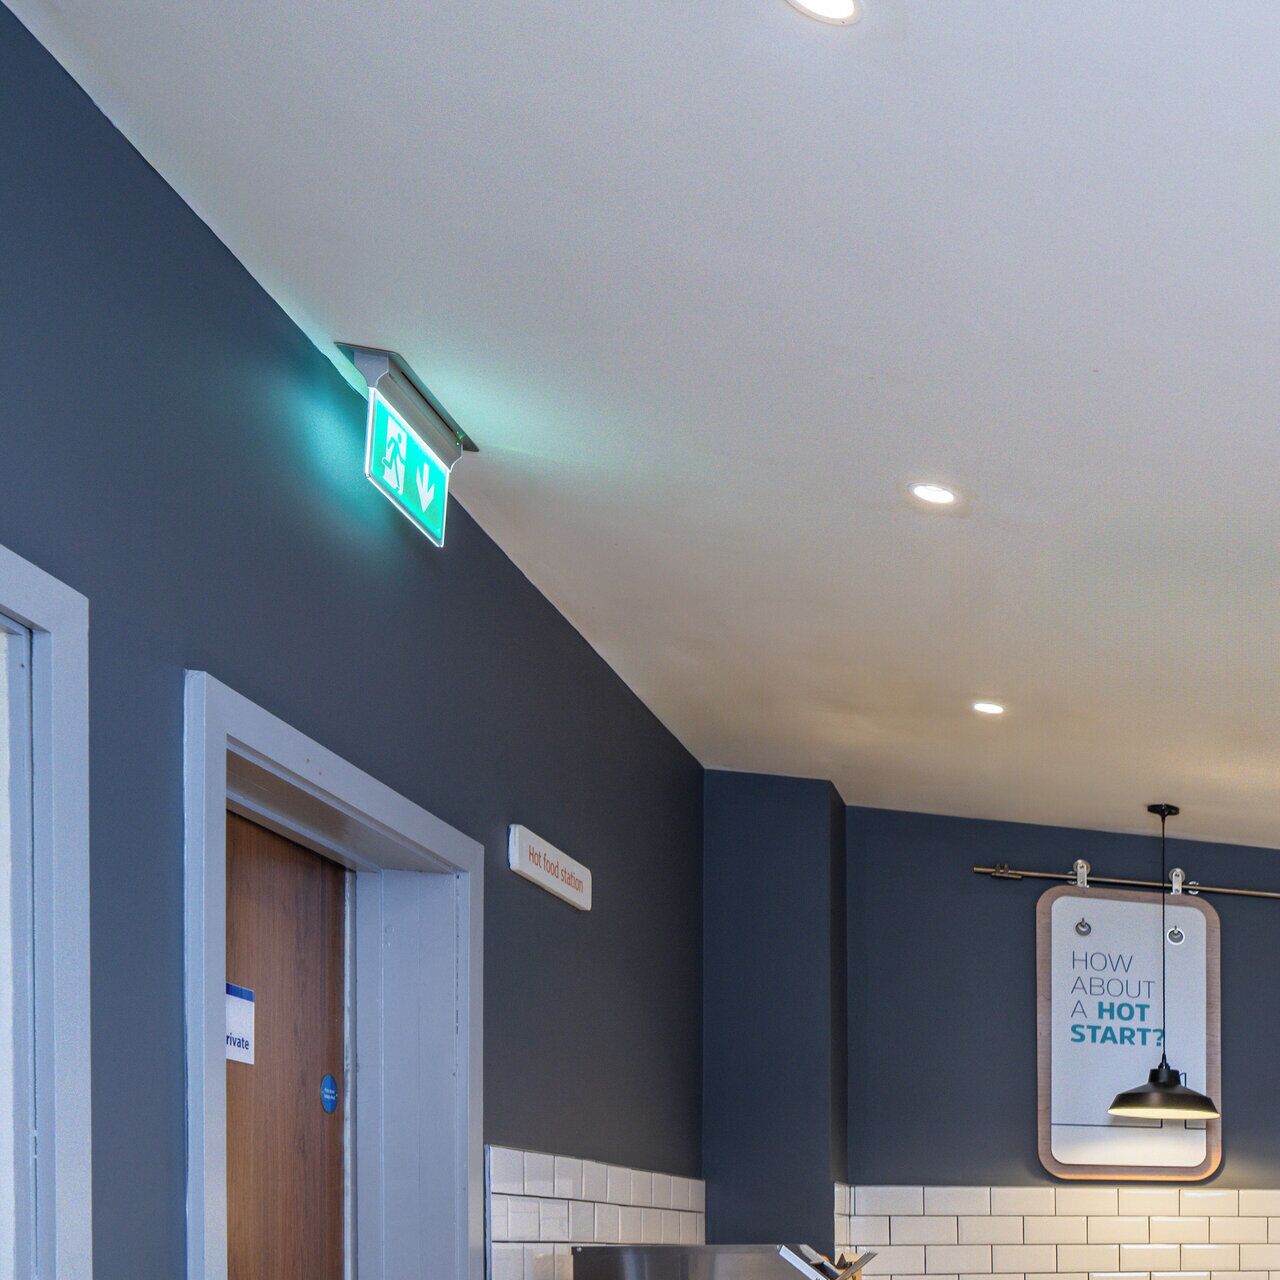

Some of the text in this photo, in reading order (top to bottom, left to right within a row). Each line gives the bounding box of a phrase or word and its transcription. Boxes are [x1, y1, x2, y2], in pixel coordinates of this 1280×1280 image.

[528, 844, 584, 894] Hot food station
[1072, 950, 1133, 972] HOW
[1070, 976, 1156, 999] ABOUT
[1070, 999, 1151, 1022] A HOT
[226, 1032, 250, 1050] rivate
[1070, 1024, 1164, 1047] START?
